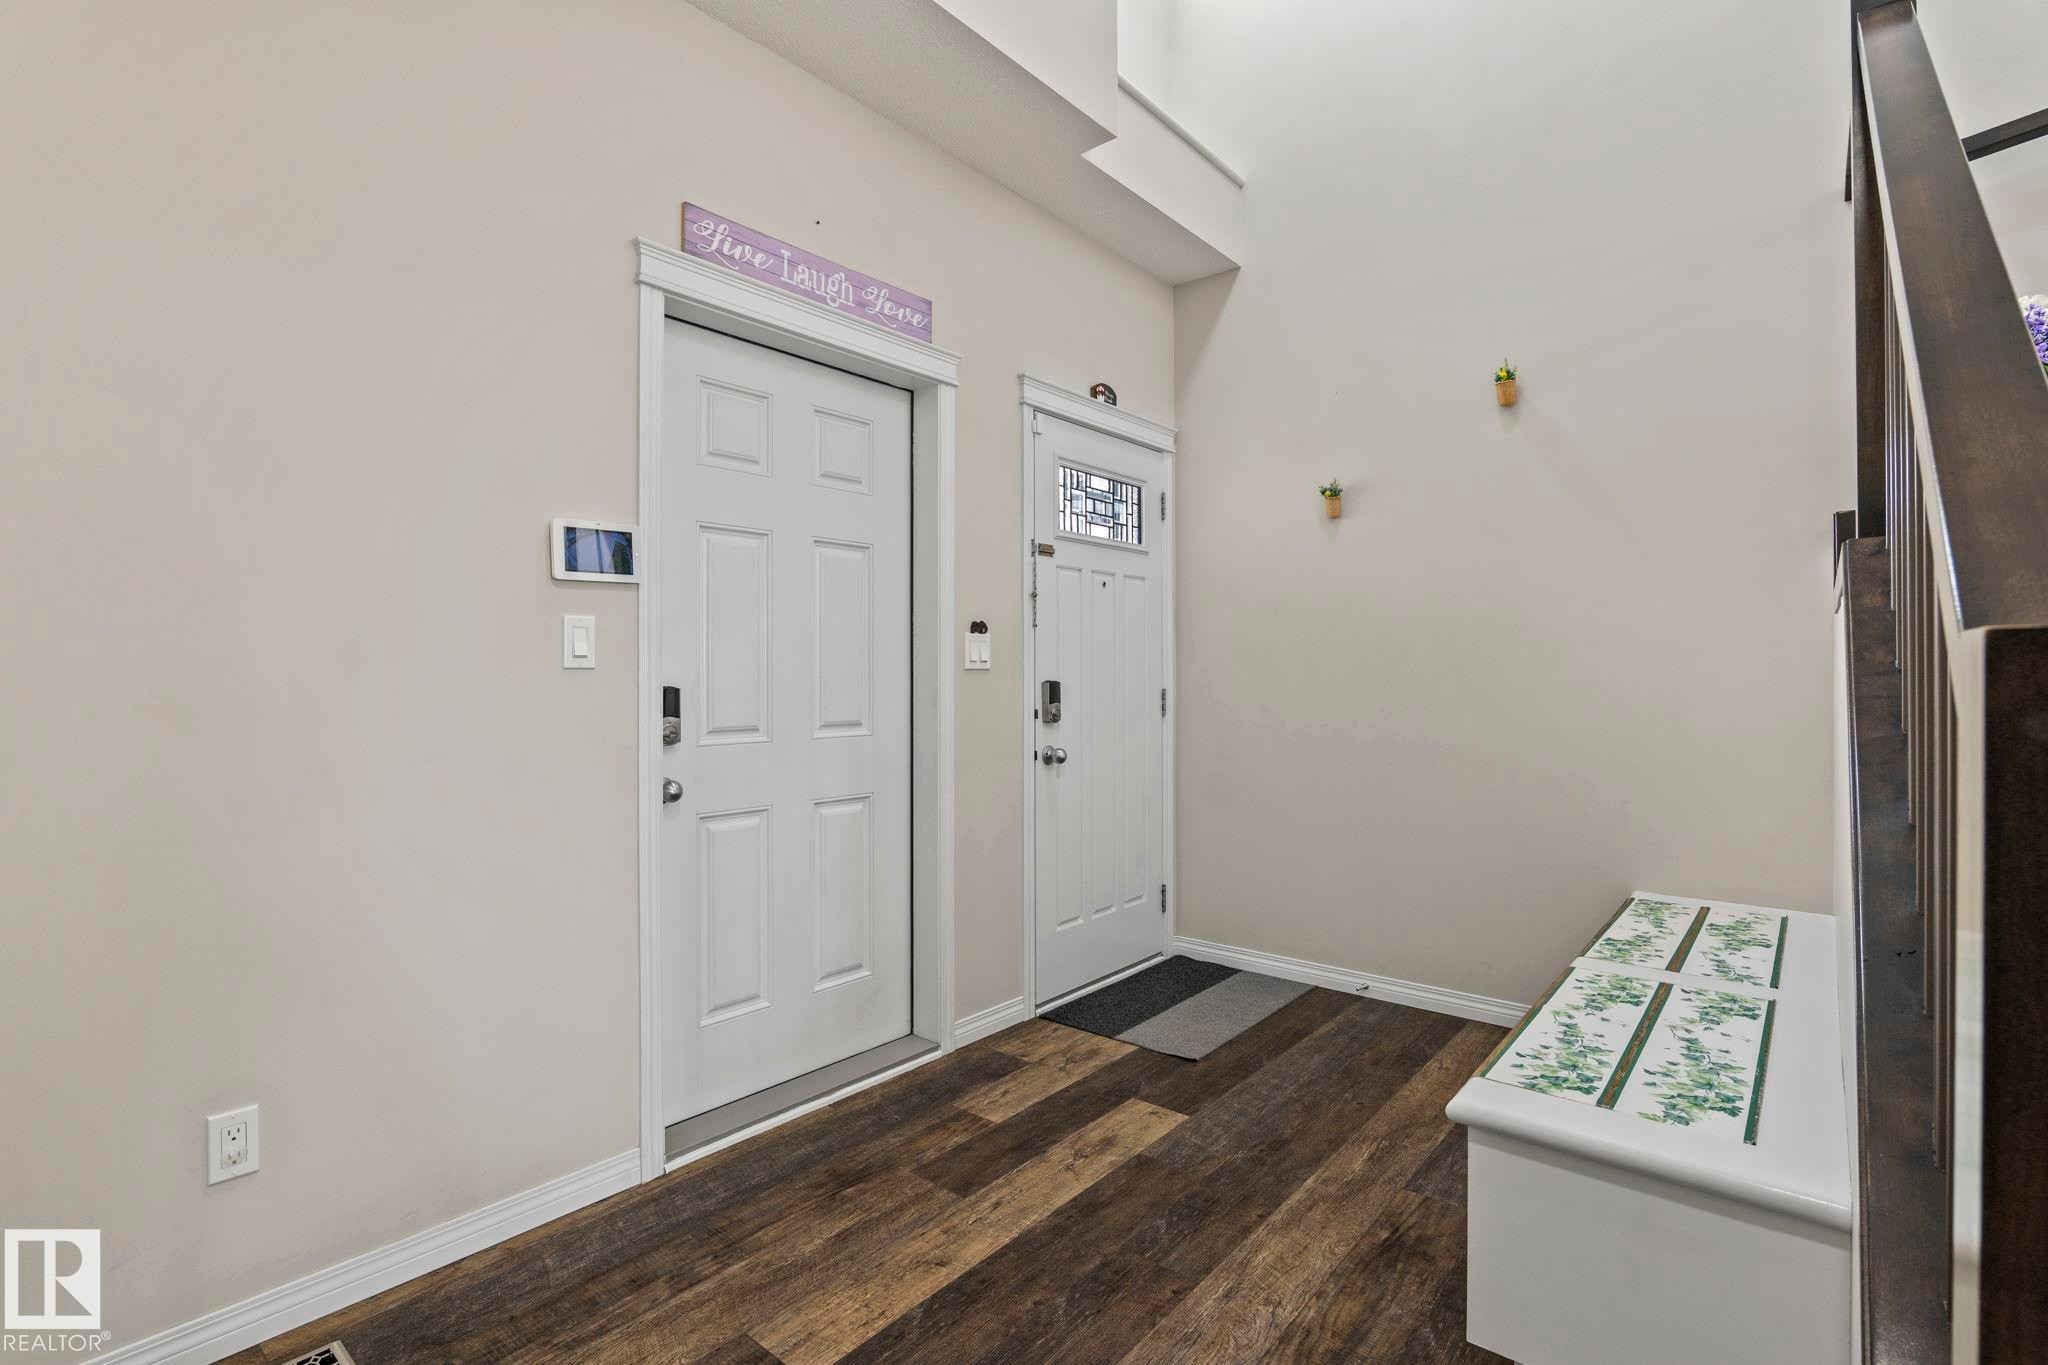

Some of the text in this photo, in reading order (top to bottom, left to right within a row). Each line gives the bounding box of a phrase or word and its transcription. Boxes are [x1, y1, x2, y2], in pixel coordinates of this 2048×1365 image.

[693, 219, 928, 328] Live Laugh Love
